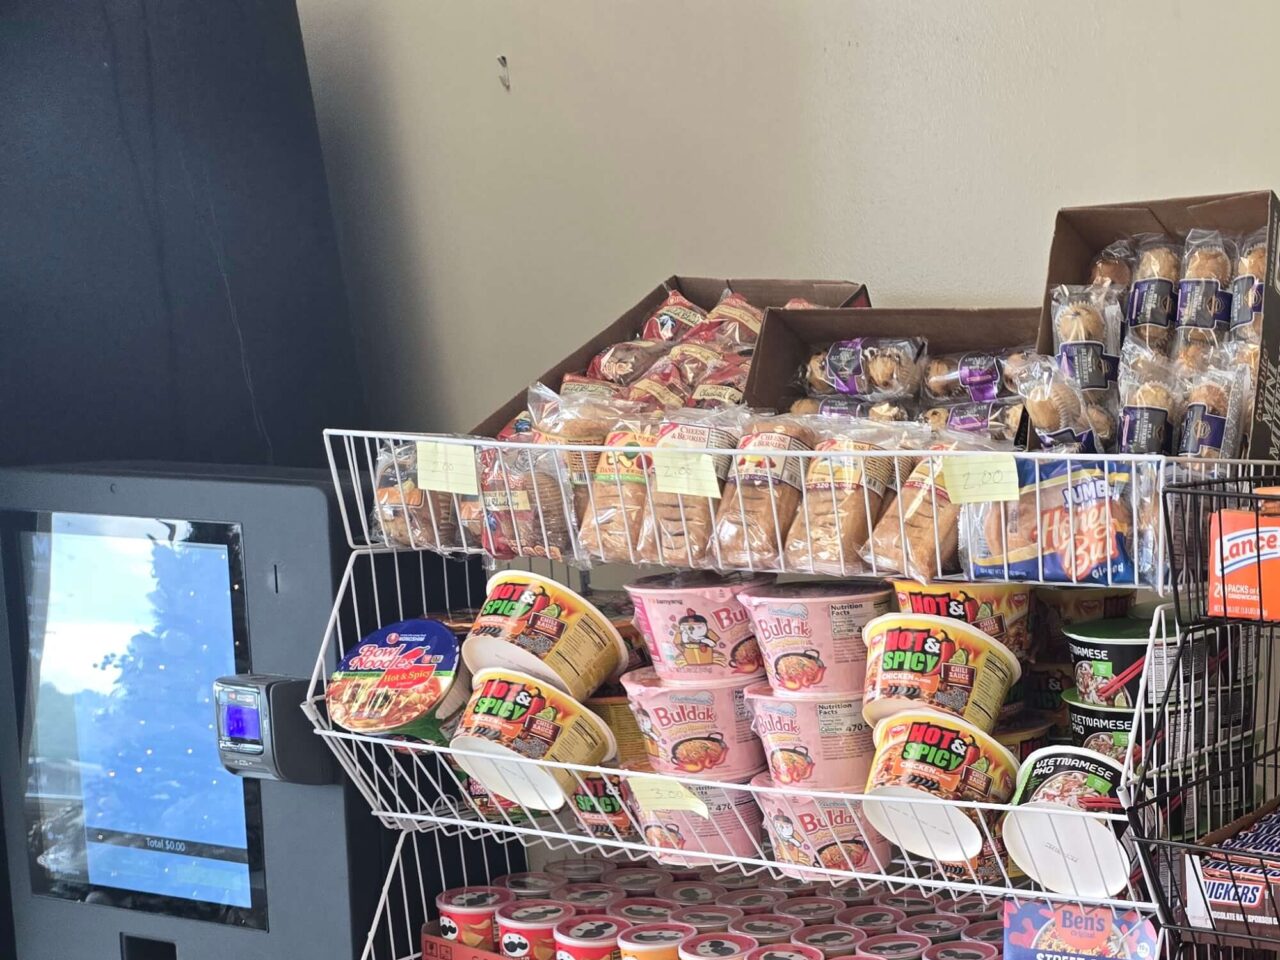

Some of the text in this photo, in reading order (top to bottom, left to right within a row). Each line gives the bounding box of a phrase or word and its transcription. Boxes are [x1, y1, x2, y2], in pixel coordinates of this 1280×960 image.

[1263, 362, 1278, 424] MINI
[482, 600, 532, 616] SPICY
[758, 618, 810, 641] Buldak
[886, 628, 941, 652] HOT &
[350, 652, 414, 670] Noodles
[361, 644, 404, 660] Bowl
[882, 651, 938, 672] SPICY
[474, 698, 528, 719] SPICY
[653, 704, 716, 729] Buldak
[758, 716, 800, 736] Buldak
[1071, 713, 1133, 730] VIETNAMESE
[908, 723, 967, 752] HOT &
[901, 742, 963, 769] SPICY
[1032, 765, 1054, 778] PHO
[1035, 757, 1114, 781] VIETNAMESE
[146, 837, 185, 851] Total $0.00
[1061, 910, 1106, 932] Ben's
